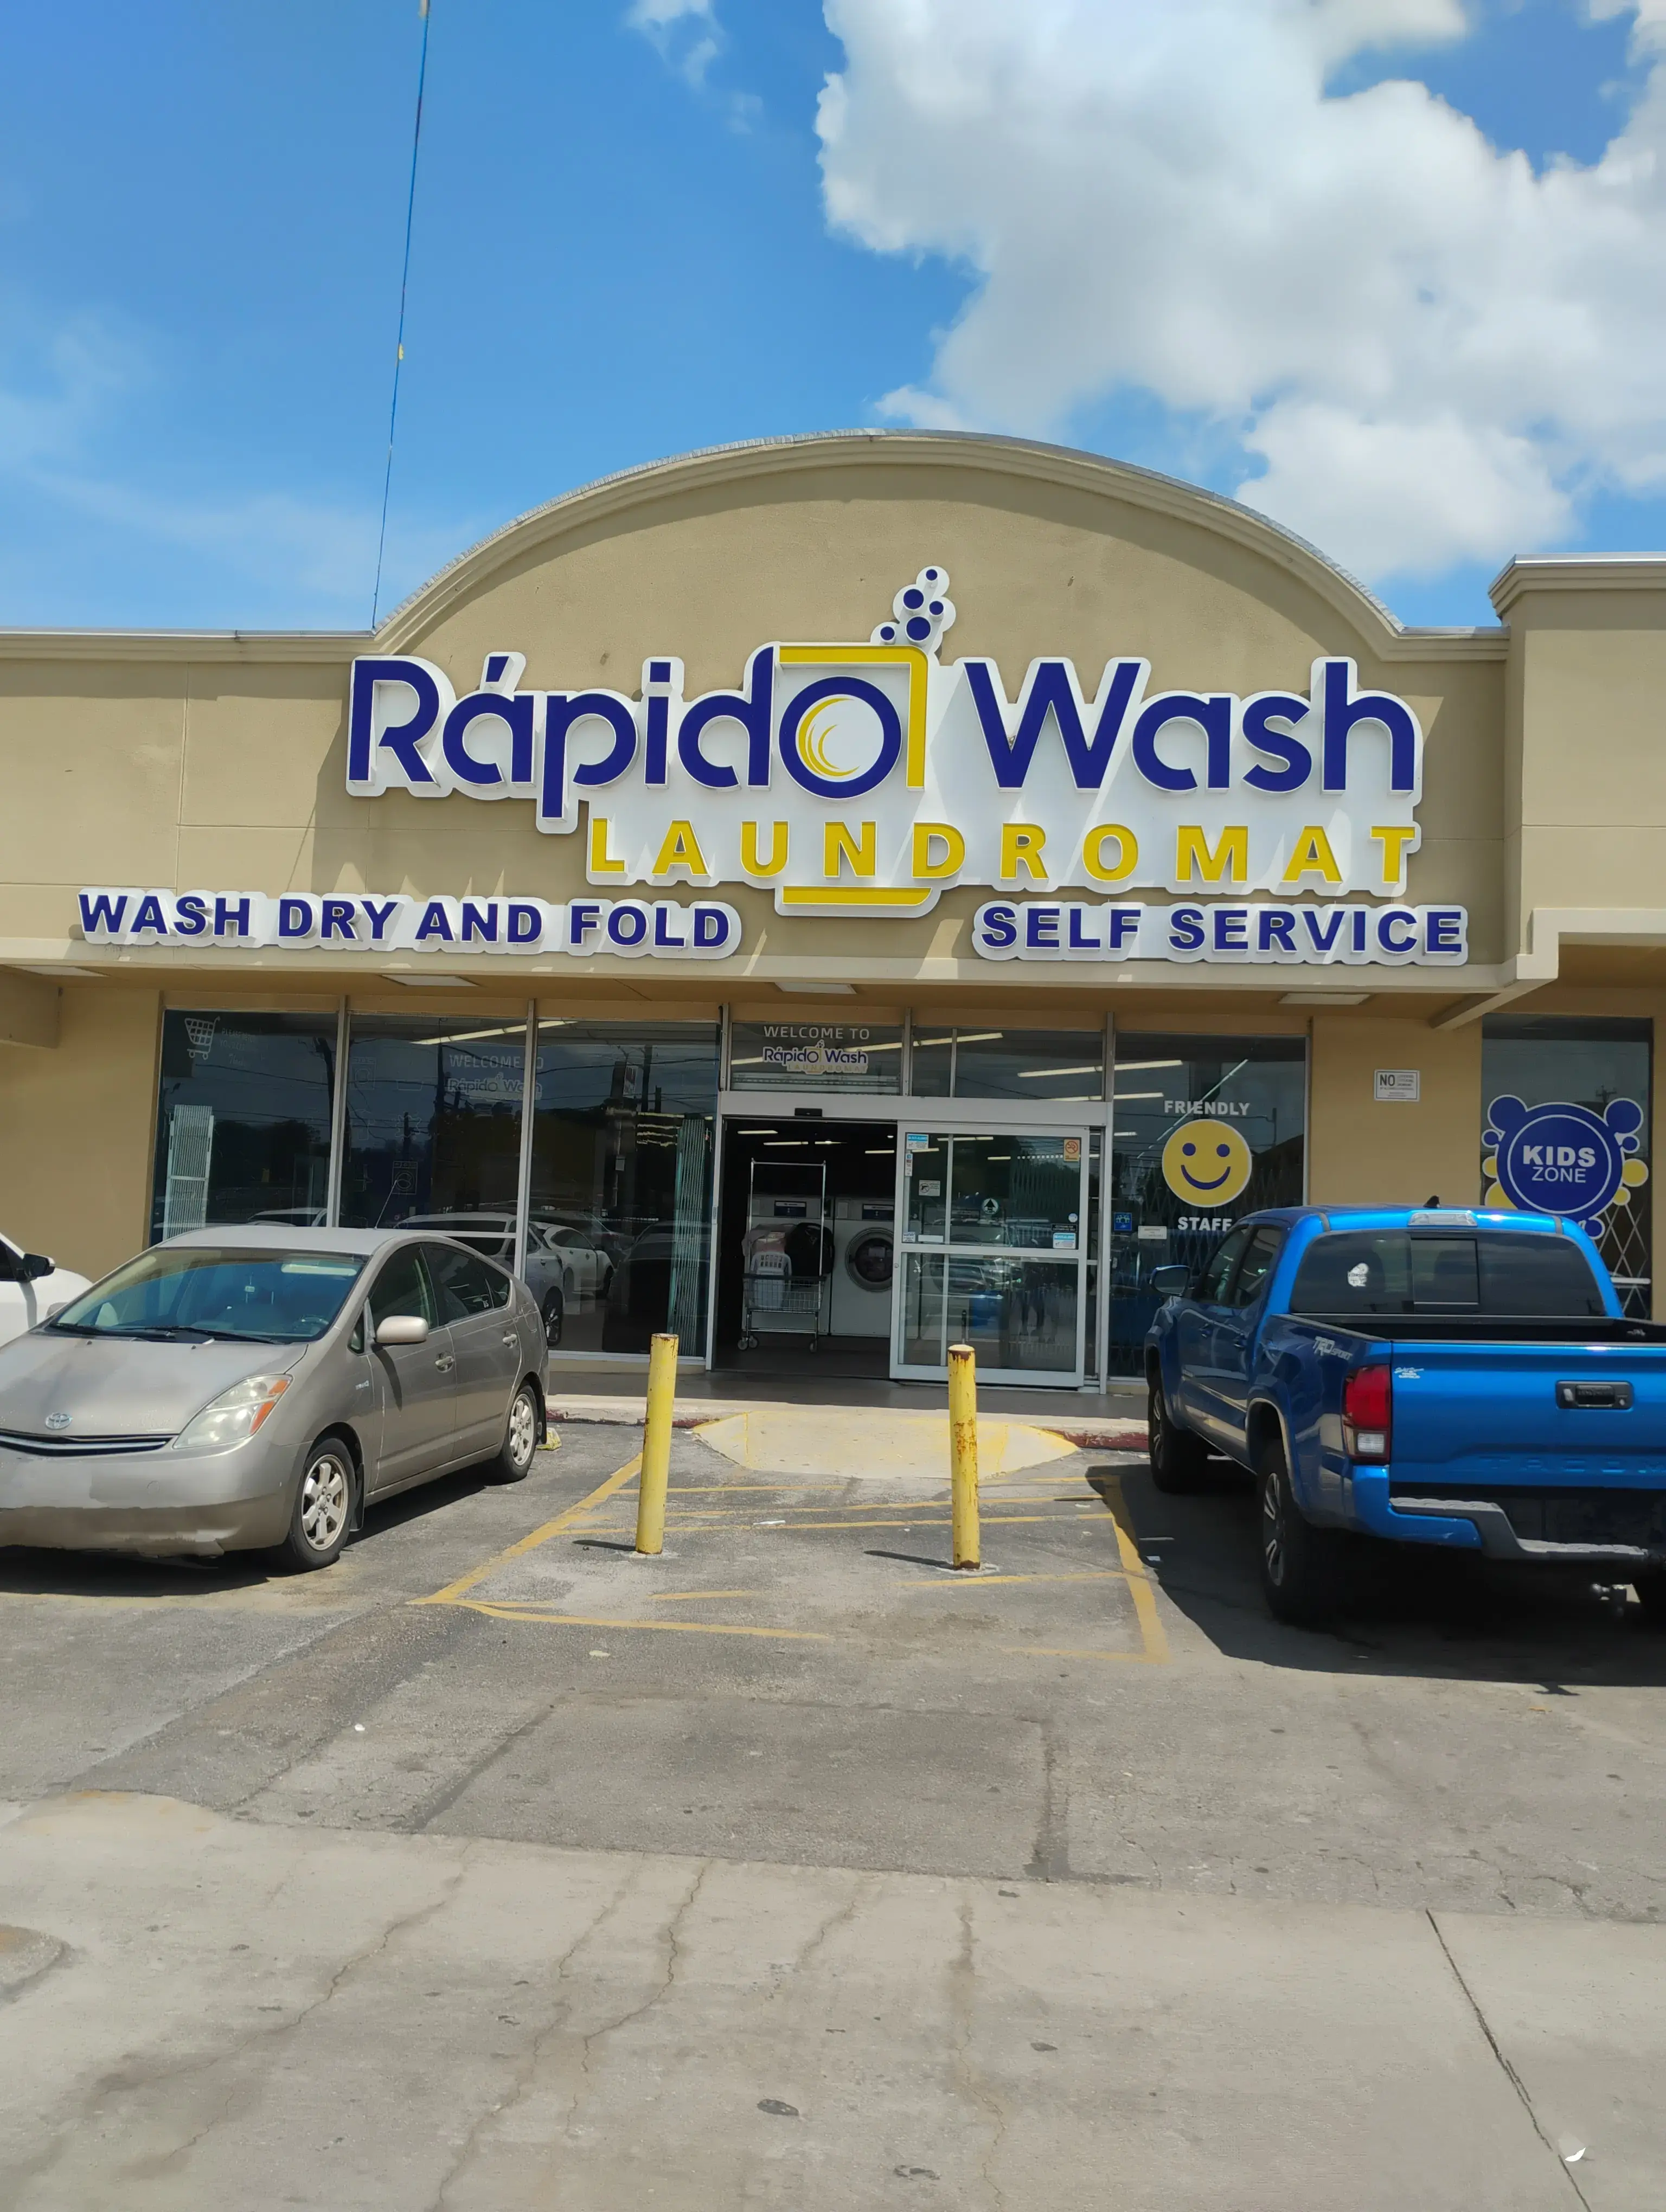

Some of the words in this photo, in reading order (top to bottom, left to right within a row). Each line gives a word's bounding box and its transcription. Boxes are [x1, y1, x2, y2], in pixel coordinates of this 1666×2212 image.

[348, 646, 902, 819] Rápido
[964, 661, 1415, 793] Wash
[590, 818, 1415, 883] LAUNDROMAT
[79, 893, 250, 936] WASH
[278, 898, 399, 940] DRY
[415, 901, 543, 944] AND
[569, 905, 729, 947] FOLD
[981, 906, 1141, 949] SELF
[1169, 909, 1463, 953] SERVICE
[764, 1026, 843, 1039] WELCOME
[849, 1028, 869, 1040] TO
[450, 1054, 521, 1069] WELCOME
[765, 1047, 819, 1064] Rápido
[824, 1049, 867, 1064] Wash
[504, 1079, 542, 1092] Wah
[1380, 1074, 1395, 1086] NO
[1164, 1100, 1250, 1116] FRIENDLY
[1523, 1145, 1595, 1167] KIDS
[1532, 1167, 1586, 1183] ZONE
[1177, 1217, 1232, 1232] STAFF
[1313, 1336, 1335, 1356] TRD
[1330, 1348, 1353, 1360] SPORT
